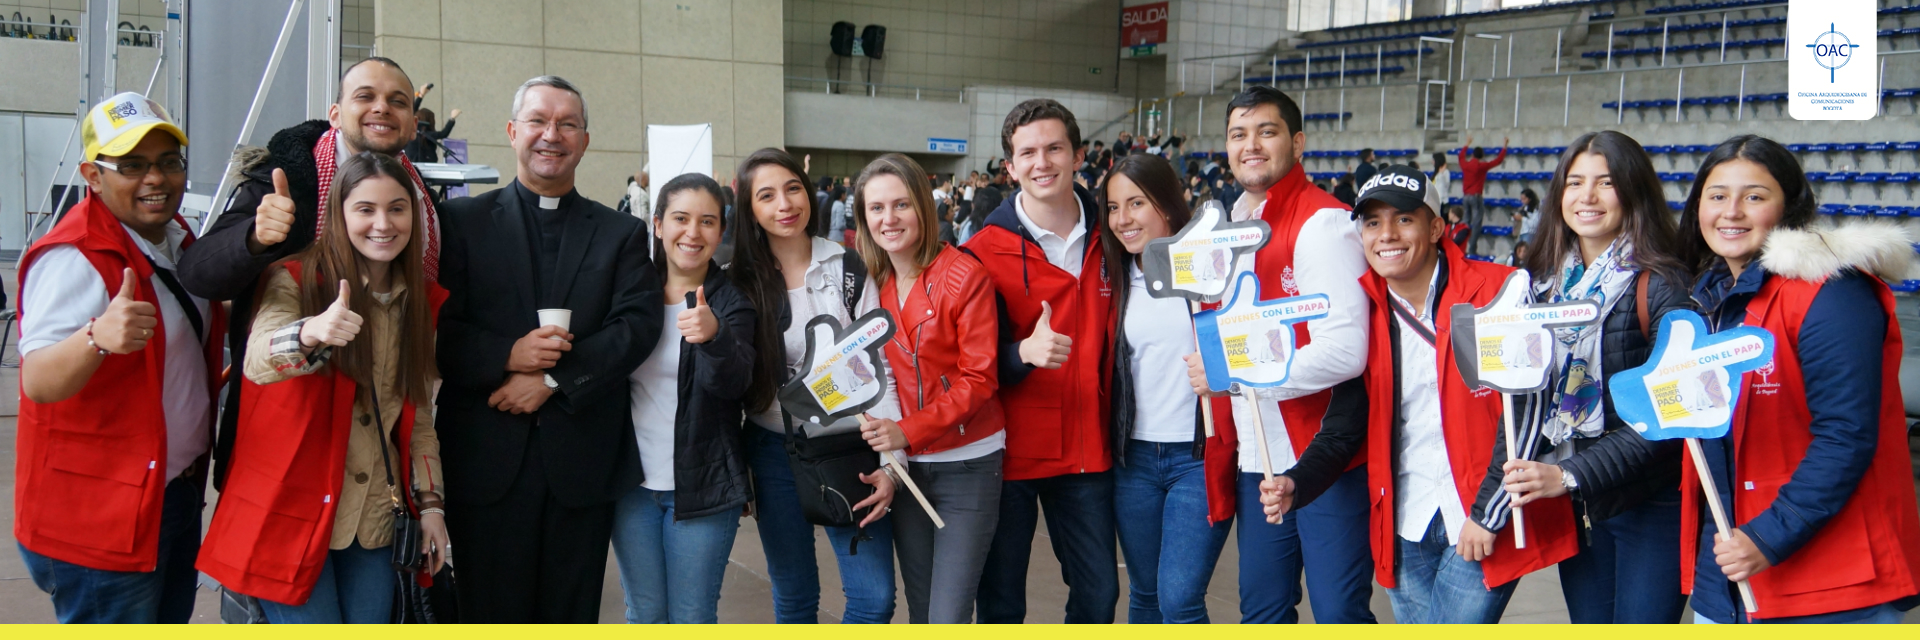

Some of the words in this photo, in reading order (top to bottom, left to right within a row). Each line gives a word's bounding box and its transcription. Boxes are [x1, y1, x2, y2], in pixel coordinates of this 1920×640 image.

[1122, 7, 1168, 27] SALIDA
[1358, 172, 1420, 197] adidas
[1180, 238, 1212, 247] JÓVENES
[1240, 232, 1260, 240] PAPA
[1220, 312, 1261, 326] JÓVENES
[1262, 308, 1282, 318] CON
[1285, 306, 1295, 314] EL
[1297, 302, 1324, 312] PAPA
[1478, 314, 1520, 325] JÓVENES
[1523, 311, 1546, 320] CON
[1562, 308, 1592, 318] PAPA
[813, 352, 843, 375] JÓVENES
[842, 341, 858, 354] CON
[858, 335, 867, 344] EL
[866, 321, 887, 337] PAPA
[1227, 347, 1249, 356] PASO
[1481, 349, 1503, 357] PASO
[1658, 359, 1697, 377] JÓVENES
[1699, 353, 1719, 365] CON
[1722, 350, 1732, 359] EL
[1734, 342, 1762, 356] PAPA
[818, 384, 839, 400] PASO
[1657, 394, 1683, 407] PASO
